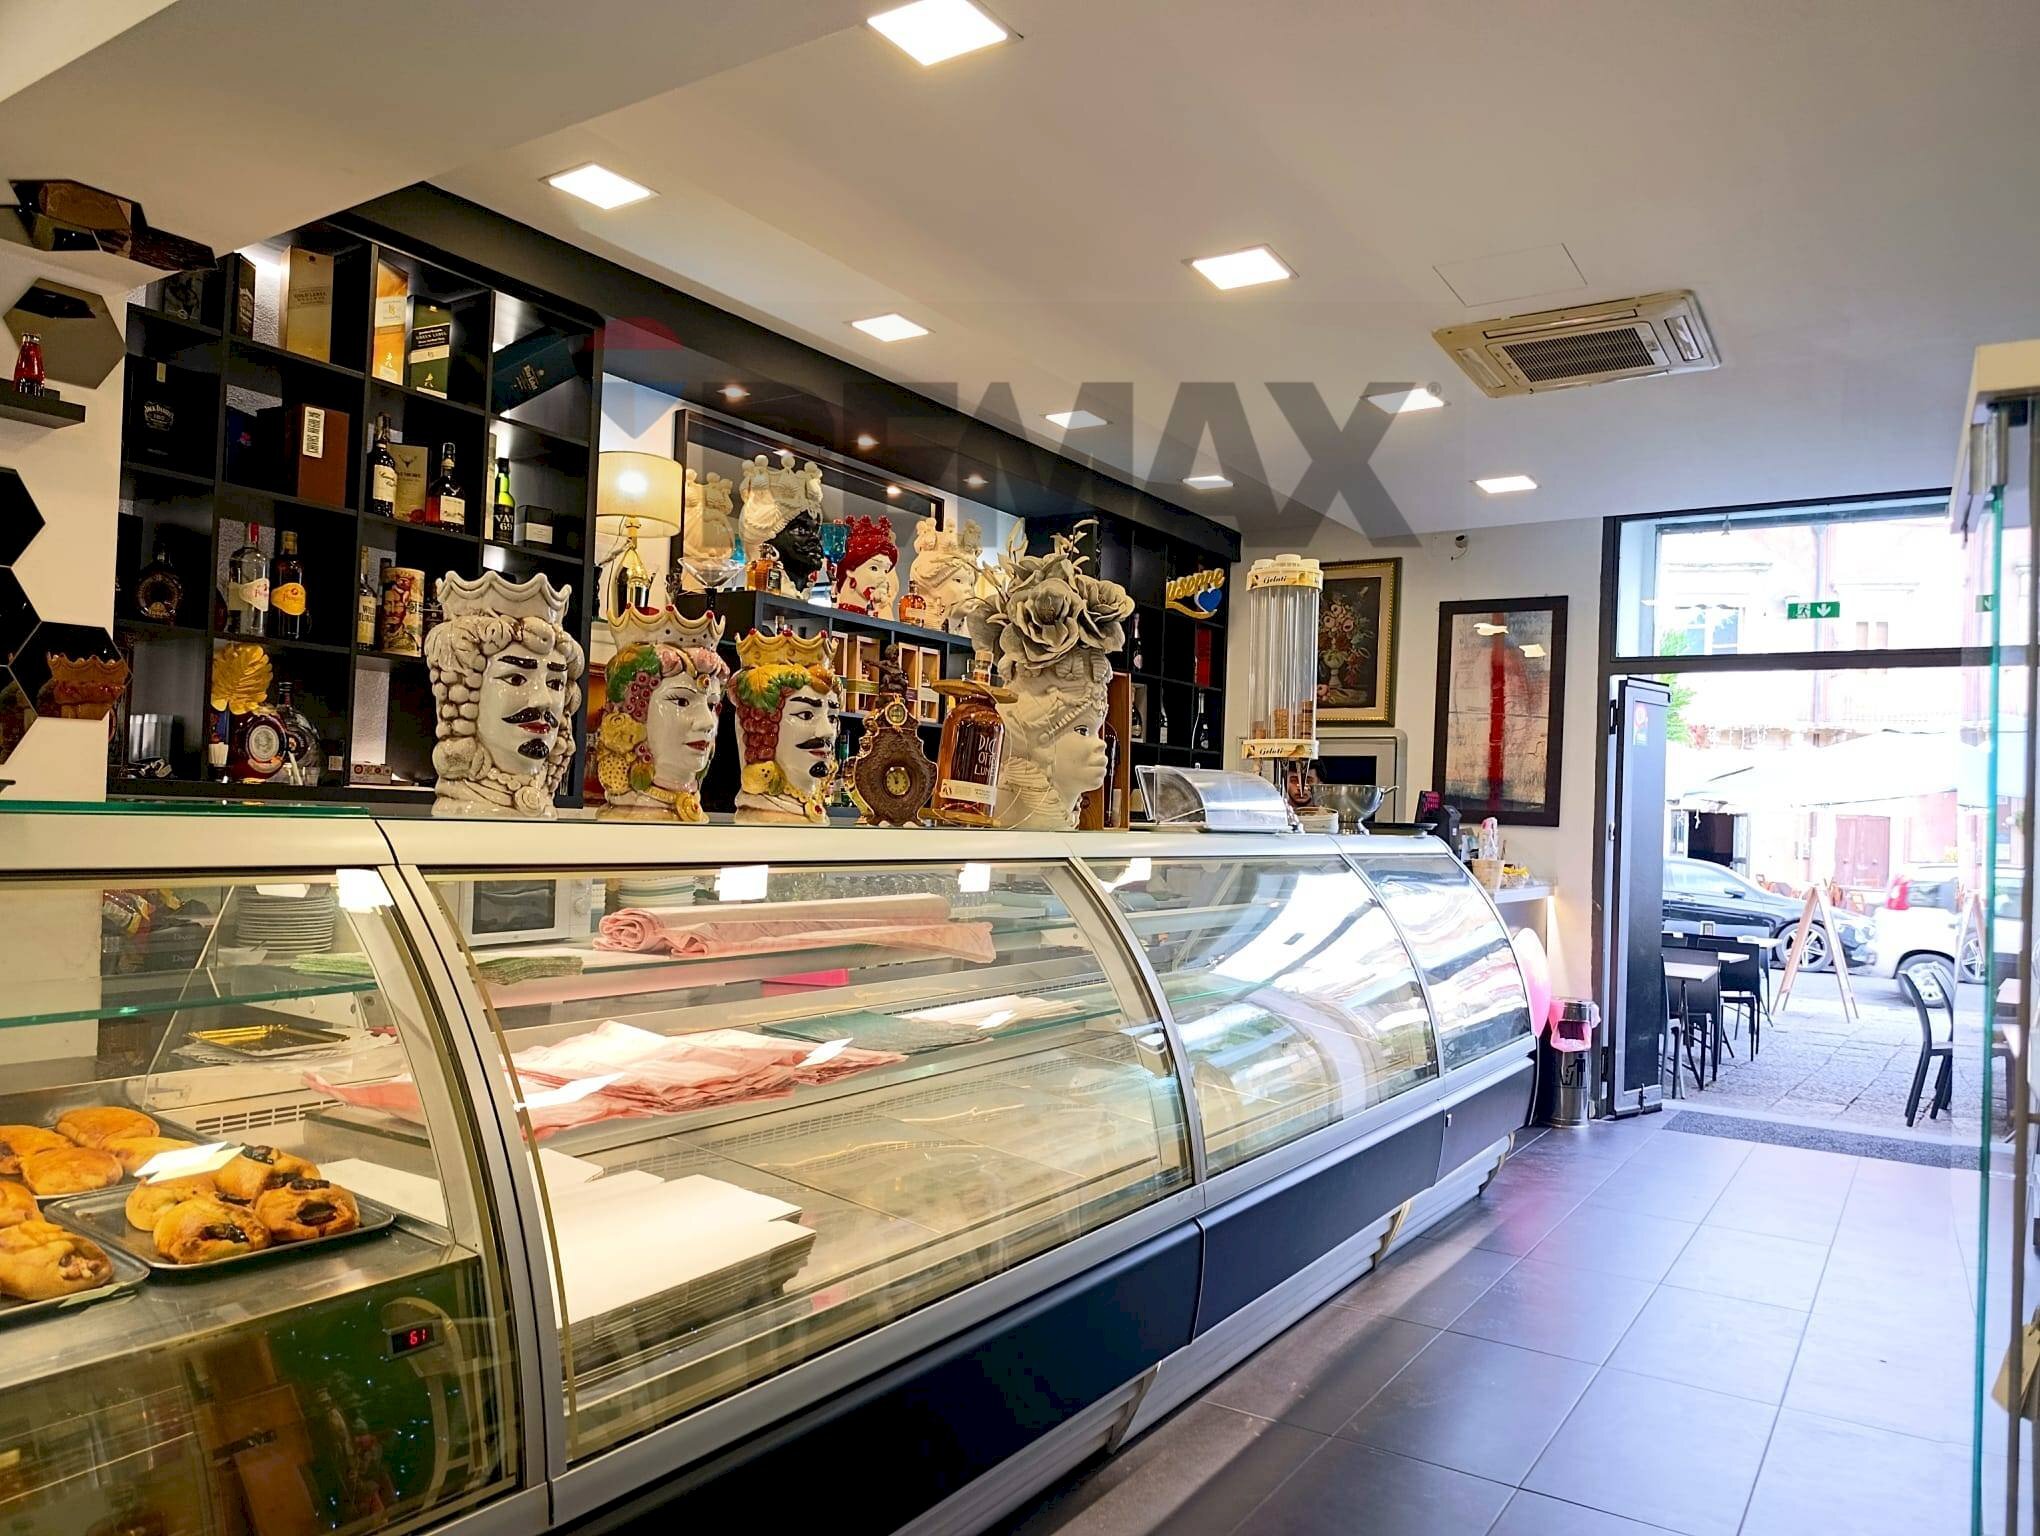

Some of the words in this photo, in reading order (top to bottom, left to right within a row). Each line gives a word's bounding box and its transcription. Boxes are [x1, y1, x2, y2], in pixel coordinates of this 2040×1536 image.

[500, 522, 513, 531] 69
[1263, 576, 1287, 584] Gelati
[1260, 747, 1283, 756] Gelati
